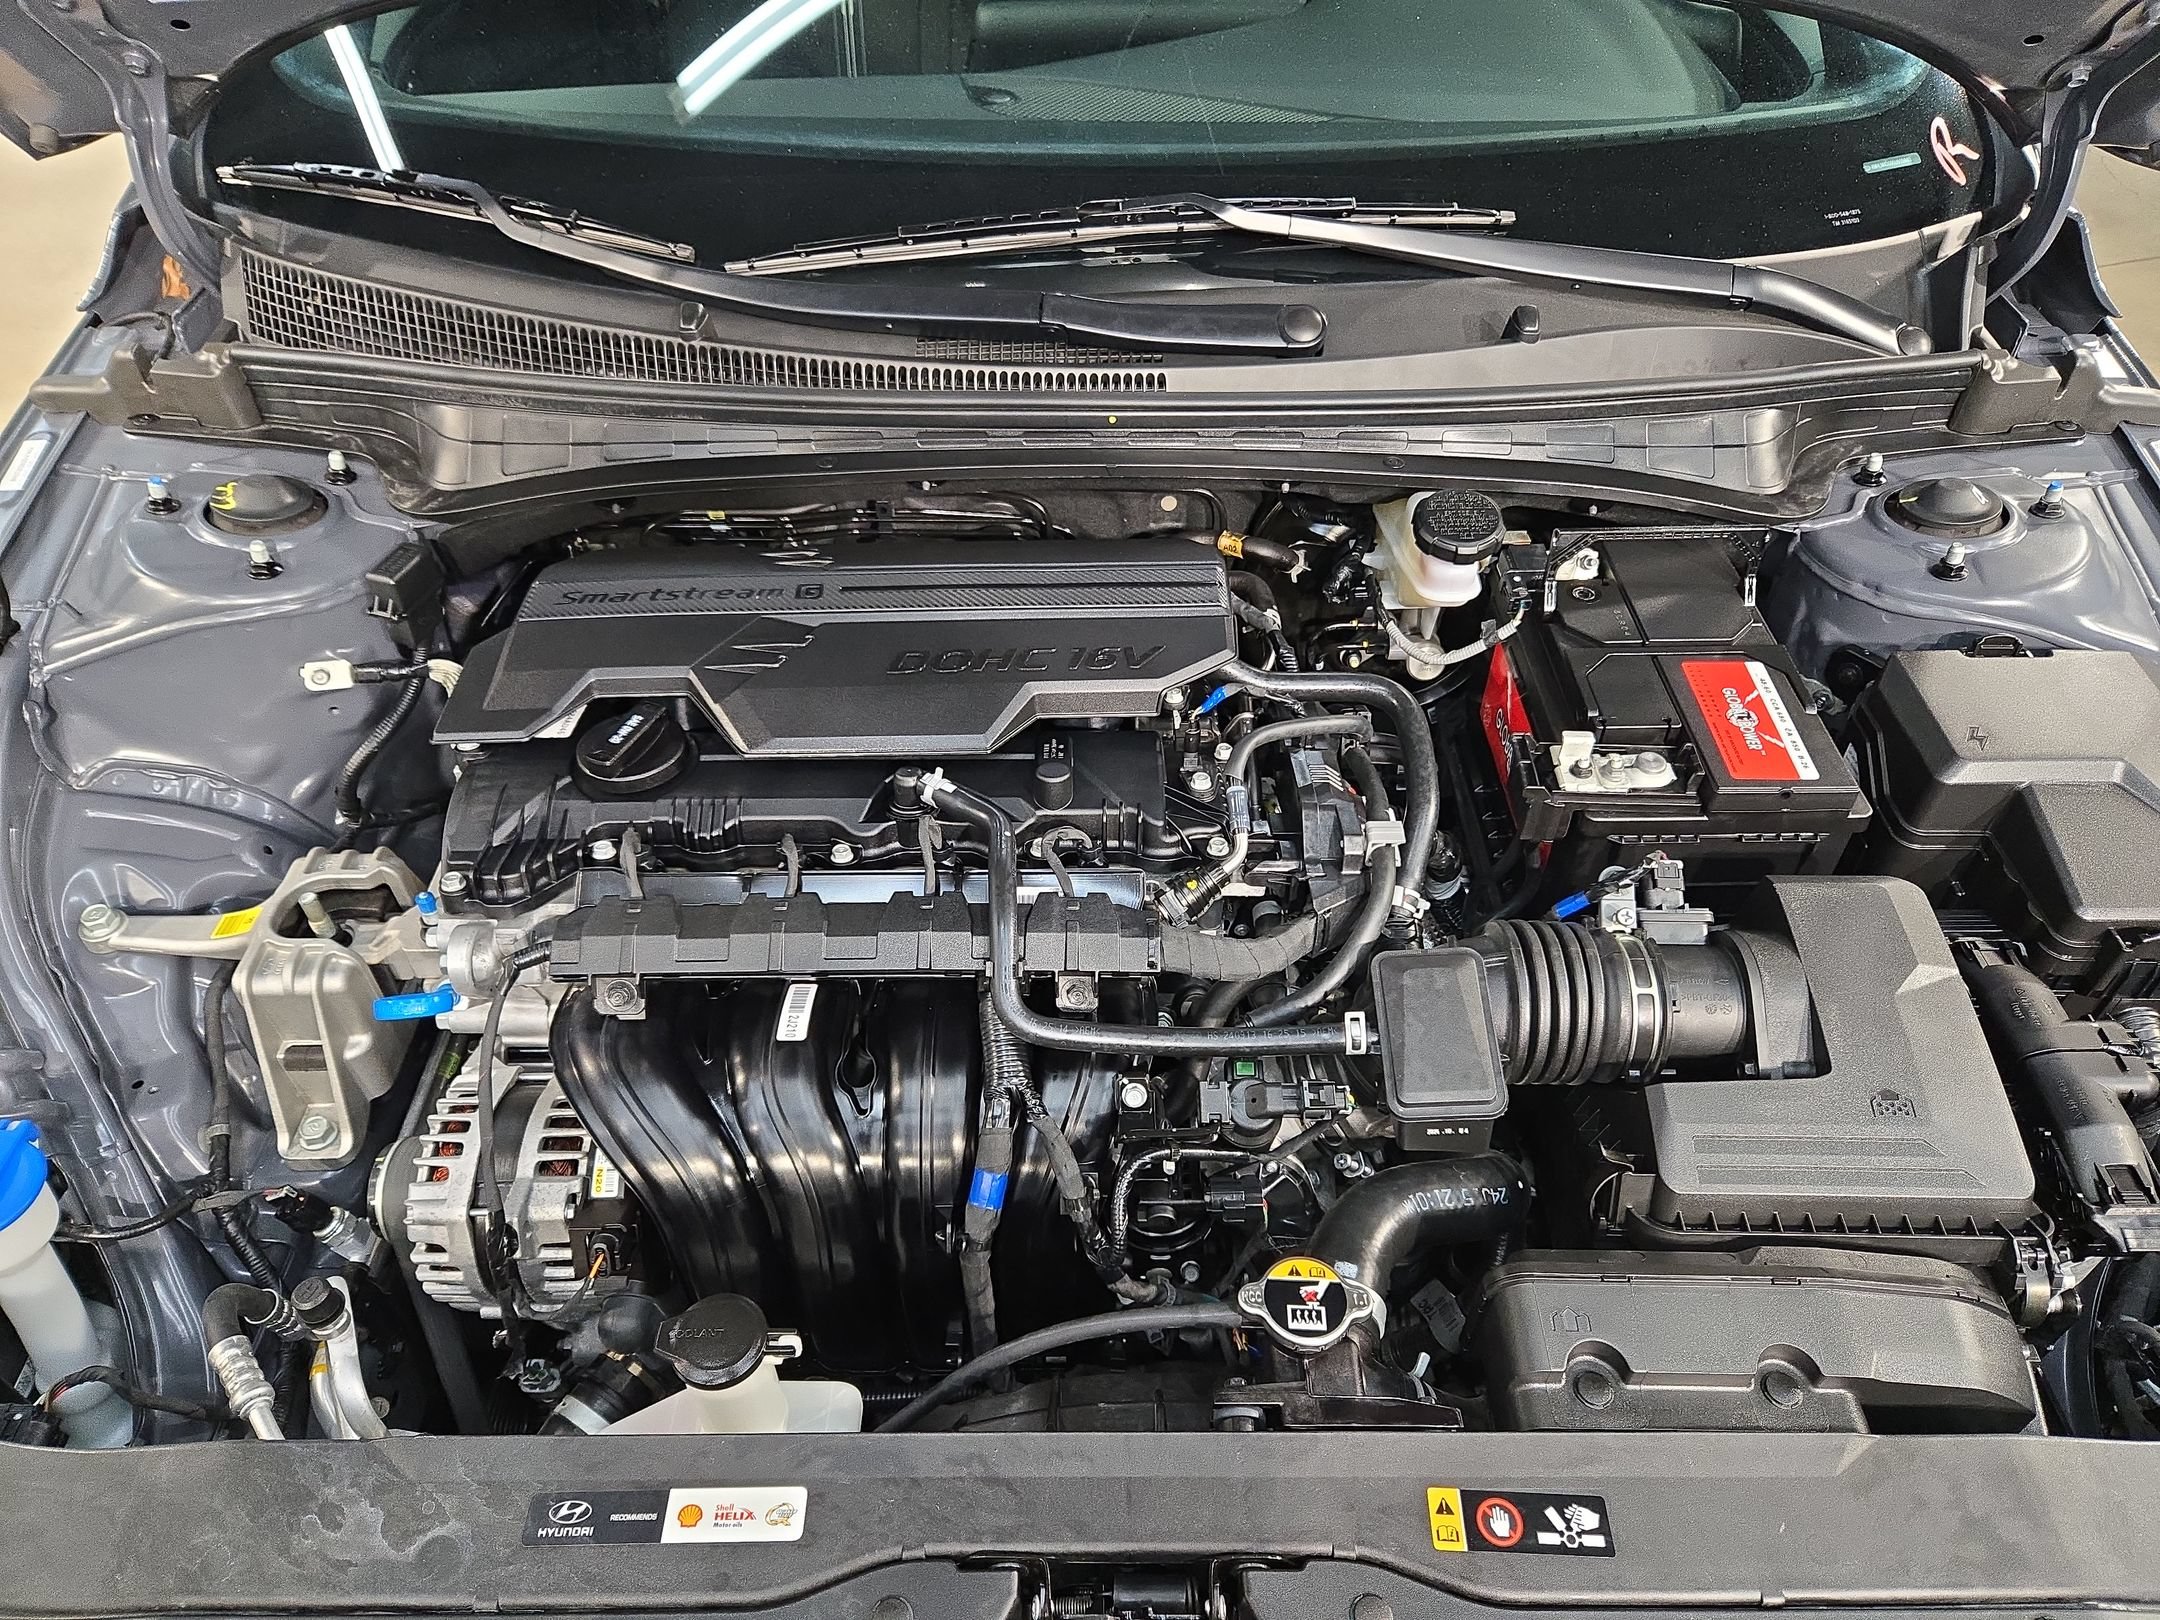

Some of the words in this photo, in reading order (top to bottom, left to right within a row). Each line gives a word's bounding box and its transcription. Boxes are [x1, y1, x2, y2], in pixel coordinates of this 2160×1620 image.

[553, 587, 785, 606] Smartstream
[886, 648, 1056, 674] DOHC
[1068, 644, 1166, 671] 16V
[1738, 719, 1763, 751] POWER
[714, 1508, 757, 1521] HELIX
[715, 1504, 735, 1512] Shell
[610, 1513, 658, 1522] RECOMMENDS
[537, 1526, 595, 1538] HYUNDAI
